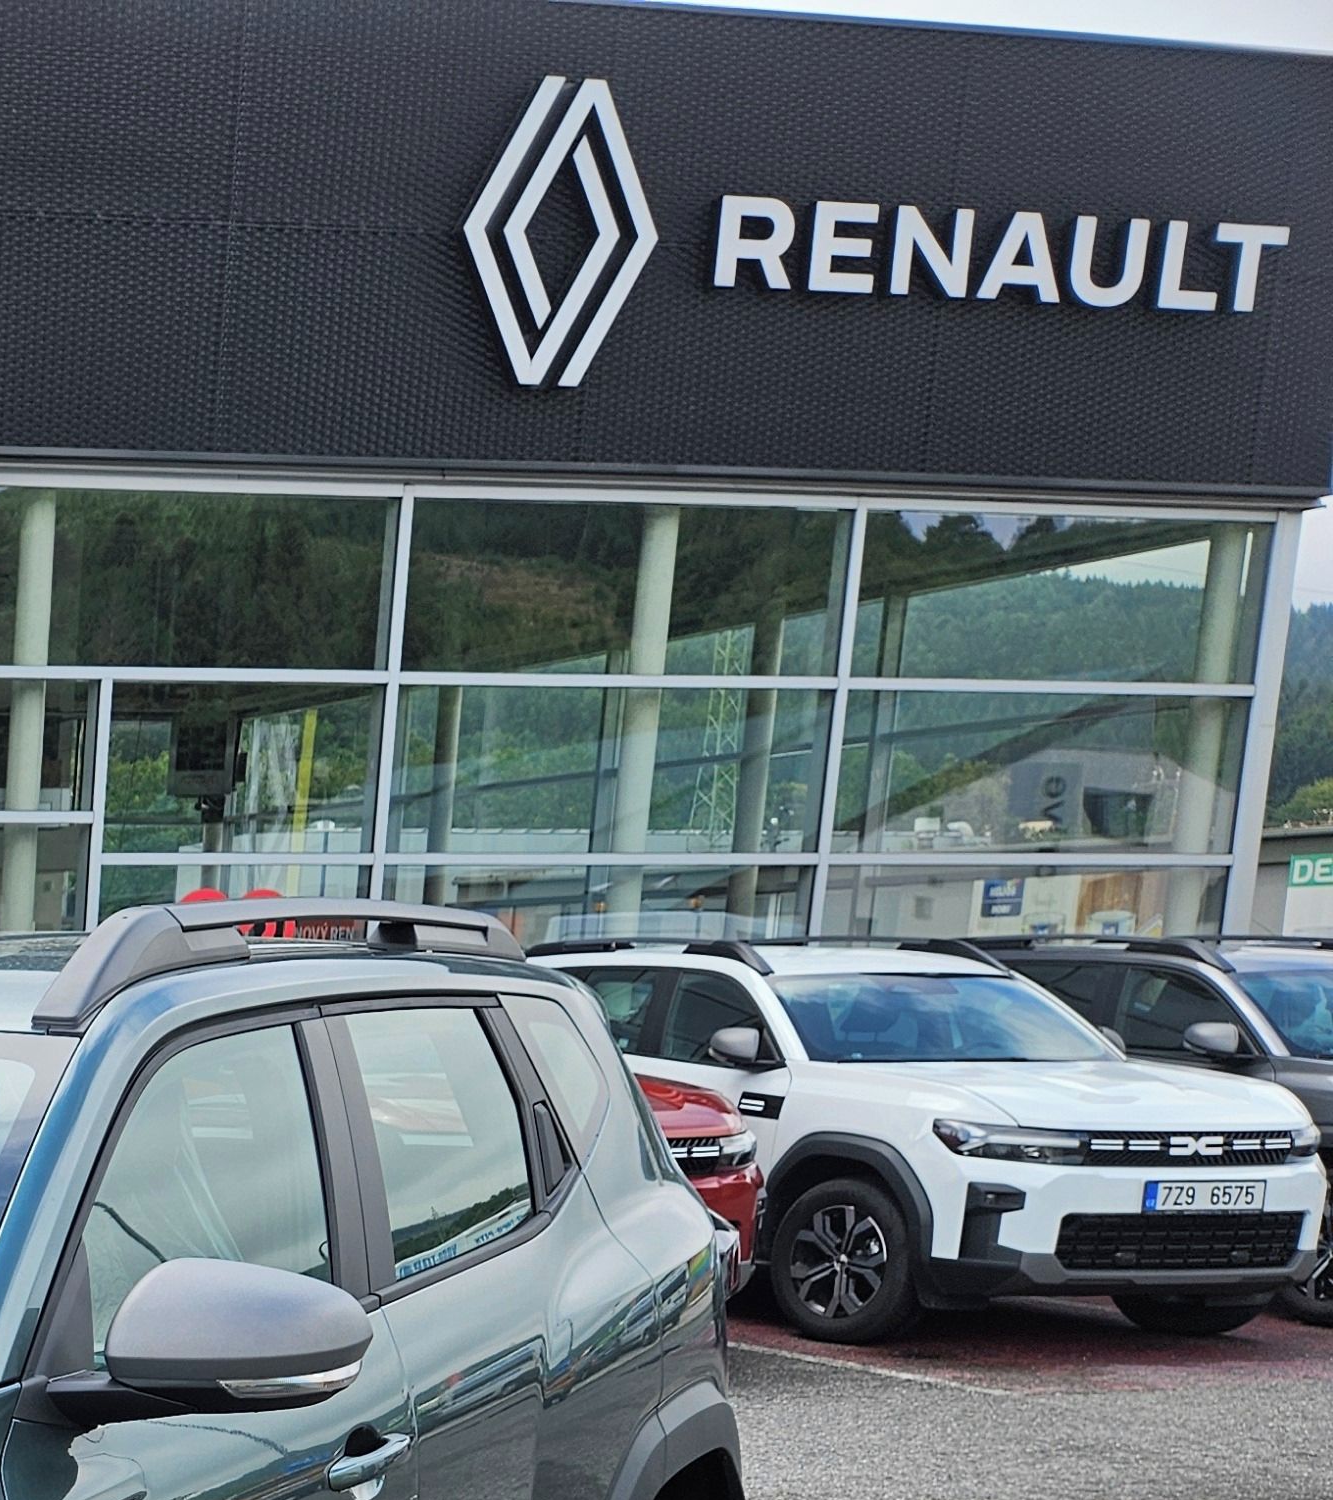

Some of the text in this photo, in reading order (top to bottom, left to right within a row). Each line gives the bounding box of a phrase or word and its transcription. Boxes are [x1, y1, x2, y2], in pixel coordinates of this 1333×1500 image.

[712, 194, 1291, 314] RENAULT
[1161, 1185, 1196, 1207] 7Z9
[1210, 1185, 1256, 1206] 6575
